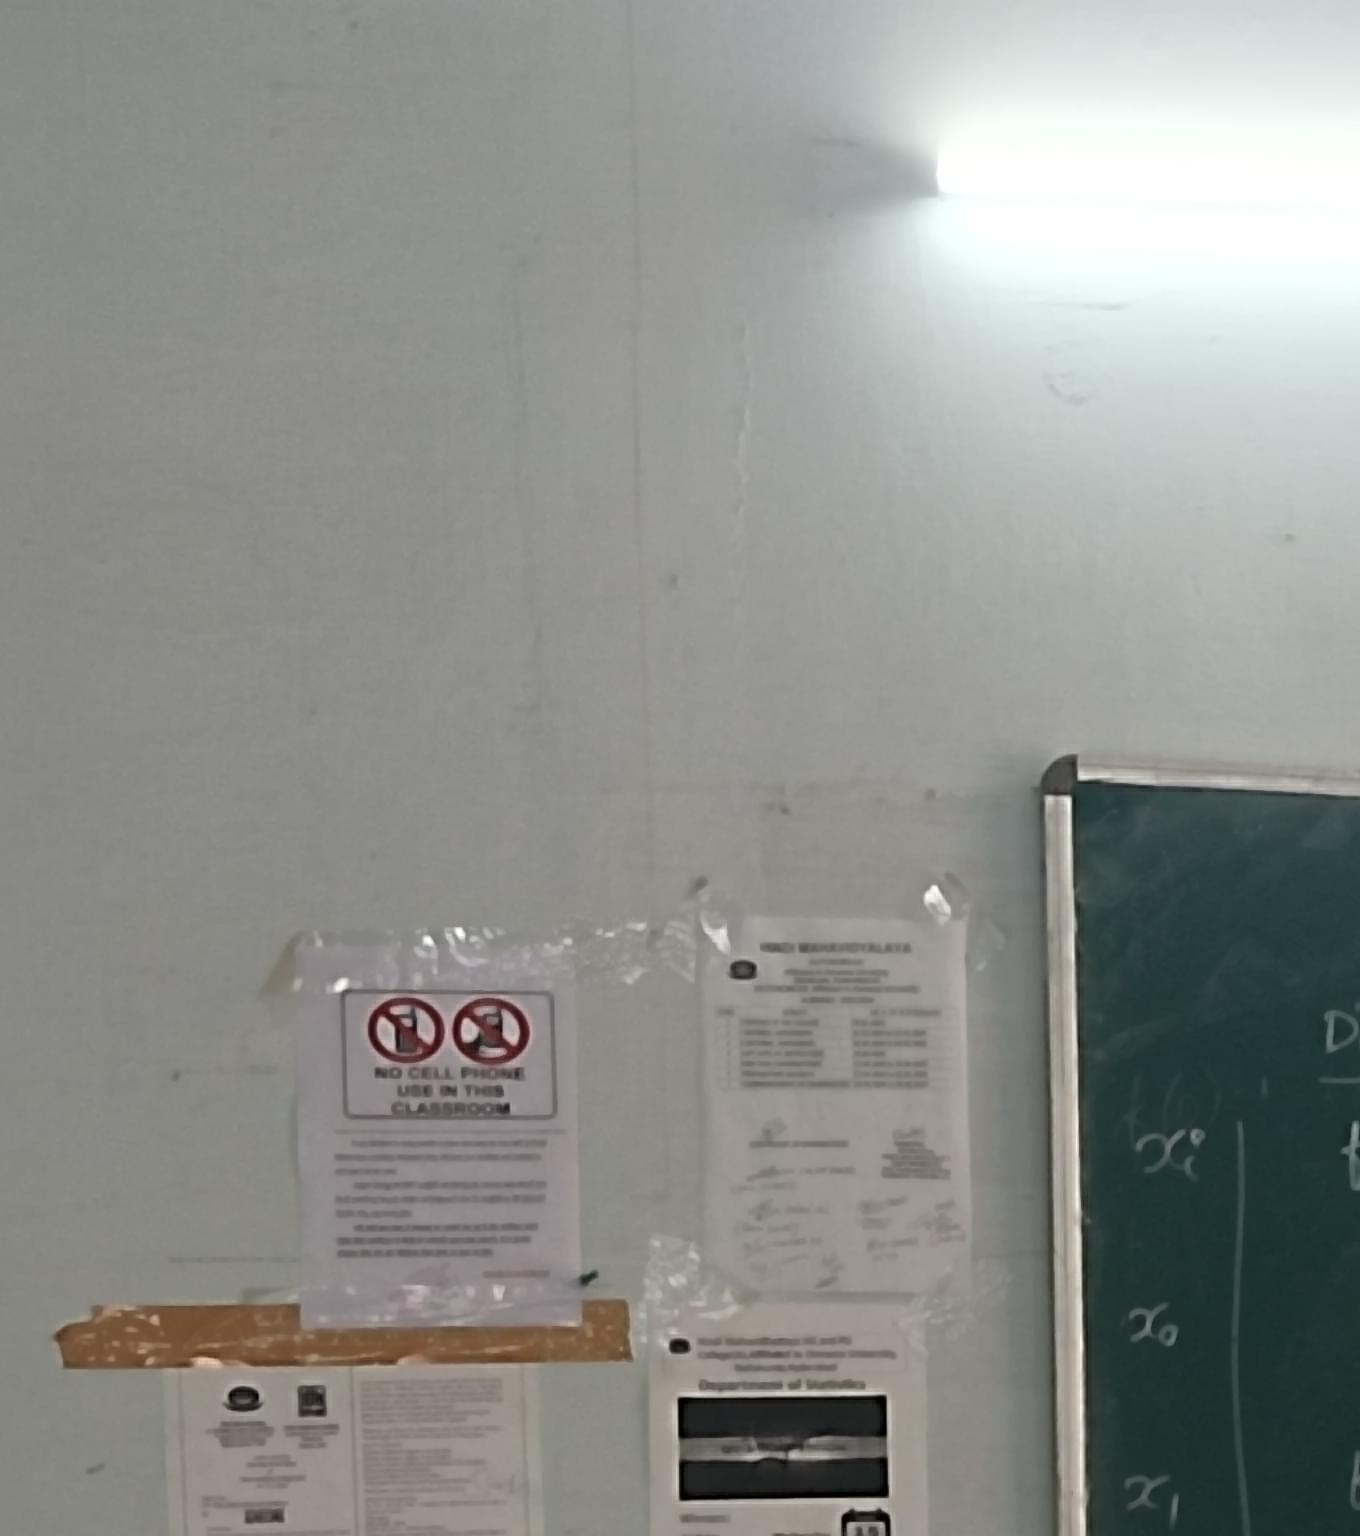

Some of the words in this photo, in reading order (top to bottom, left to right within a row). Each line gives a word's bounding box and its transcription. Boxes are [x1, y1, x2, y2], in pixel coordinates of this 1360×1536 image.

[374, 1066, 402, 1080] NO
[407, 1066, 454, 1080] CELL
[461, 1067, 526, 1081] PHONE
[397, 1084, 433, 1098] USE
[439, 1085, 458, 1098] IN
[465, 1085, 505, 1098] THIS
[391, 1102, 511, 1116] CLASSROOM
